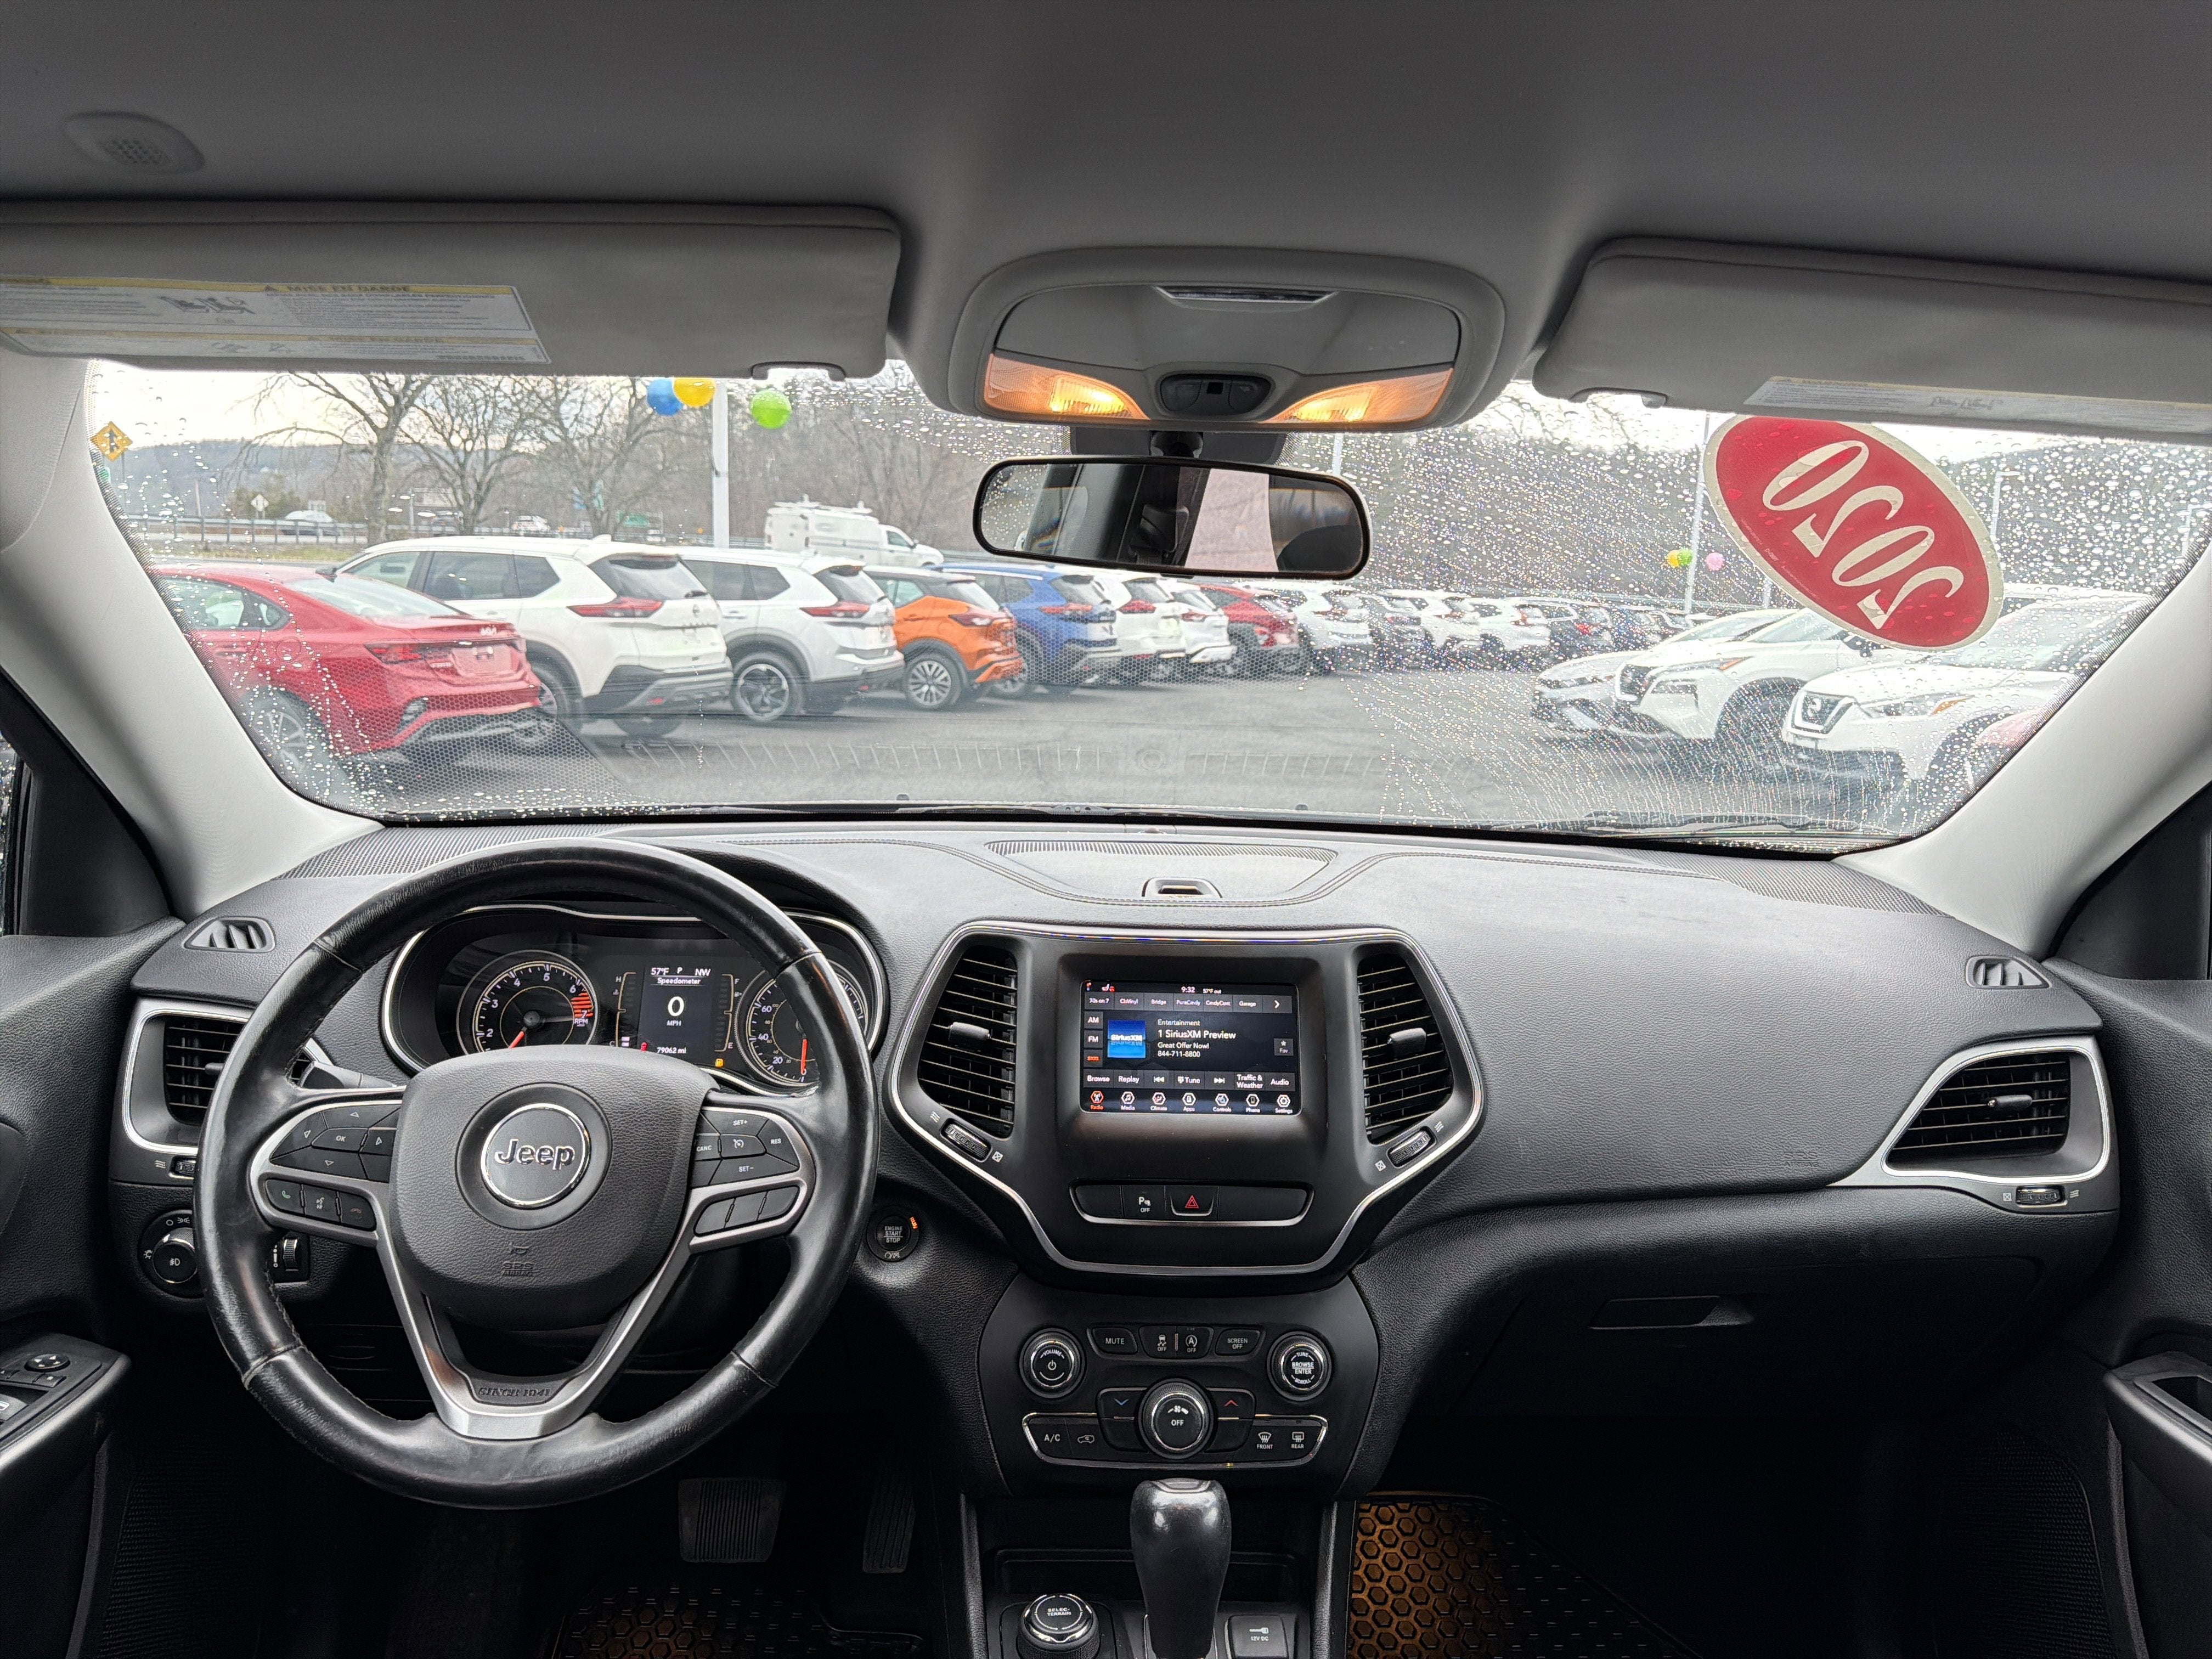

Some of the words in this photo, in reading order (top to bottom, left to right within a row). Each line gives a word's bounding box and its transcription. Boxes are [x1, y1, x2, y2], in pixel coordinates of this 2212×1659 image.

[544, 973, 550, 981] 5
[695, 968, 710, 977] NW
[514, 978, 521, 987] 4
[569, 985, 576, 993] 6
[491, 1000, 498, 1008] 3
[668, 996, 684, 1017] 0
[487, 1029, 493, 1037] 2
[1158, 1029, 1163, 1038] 1
[1165, 1029, 1201, 1038] SiriusXM
[1203, 1030, 1236, 1039] Preview
[1118, 1075, 1140, 1084] Replay
[494, 1138, 575, 1170] Jeep
[909, 1216, 918, 1229] RUN
[502, 1261, 534, 1269] SRS
[1044, 1433, 1060, 1442] A/C
